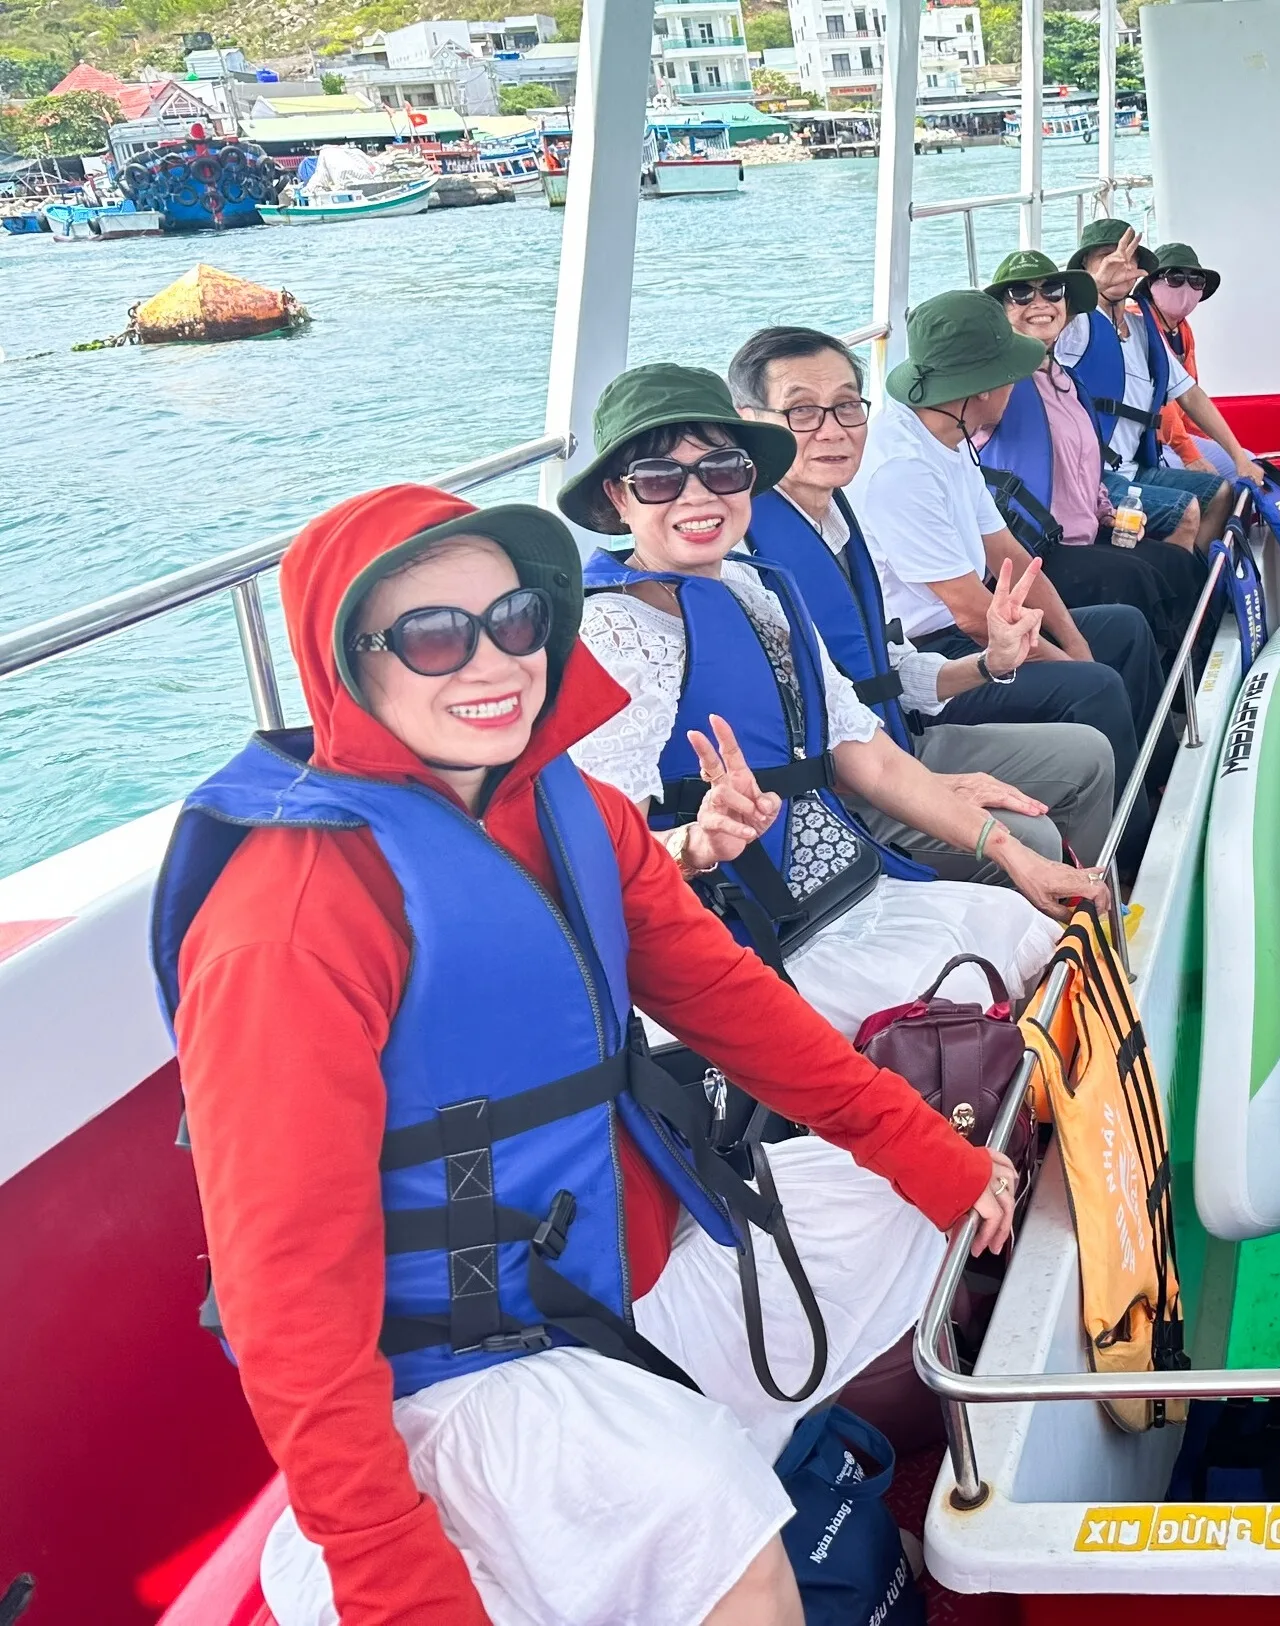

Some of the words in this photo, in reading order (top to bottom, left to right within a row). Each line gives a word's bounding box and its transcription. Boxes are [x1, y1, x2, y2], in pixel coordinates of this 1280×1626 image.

[809, 1534, 833, 1564] Ngân
[825, 1502, 852, 1535] hàng
[1157, 1513, 1252, 1545] ĐỪNG
